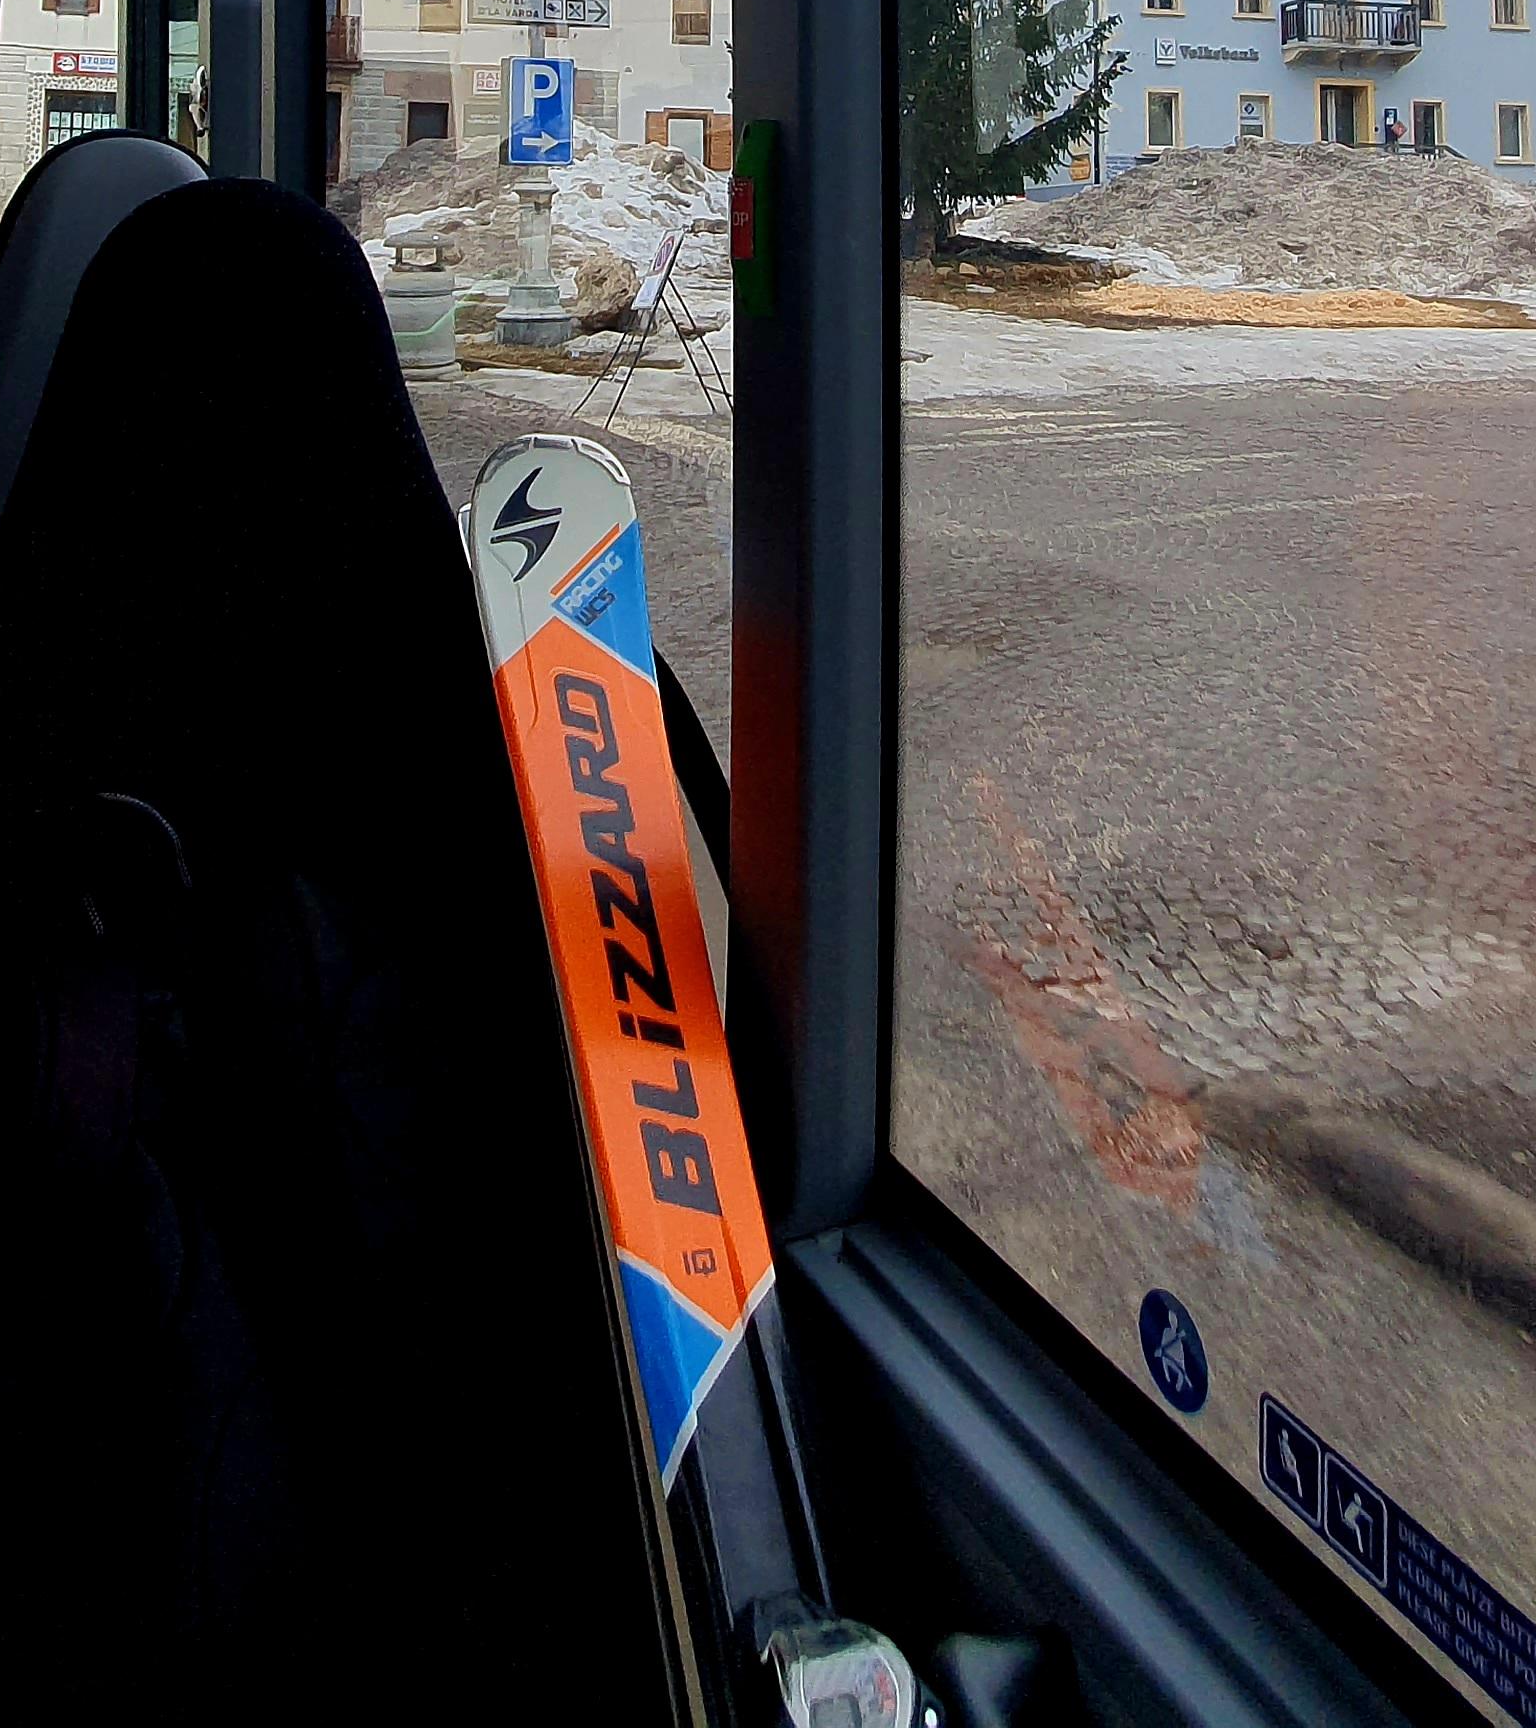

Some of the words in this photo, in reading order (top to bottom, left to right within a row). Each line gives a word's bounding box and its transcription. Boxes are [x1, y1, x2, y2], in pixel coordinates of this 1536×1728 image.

[524, 64, 559, 117] P
[559, 551, 624, 614] RACING
[574, 587, 617, 627] WCS
[682, 1247, 718, 1278] IQ
[1398, 1578, 1452, 1644] PLEASE
[1455, 1633, 1489, 1677] GIVE
[1493, 1666, 1516, 1698] UP
[1455, 1603, 1511, 1668] QUESTI
